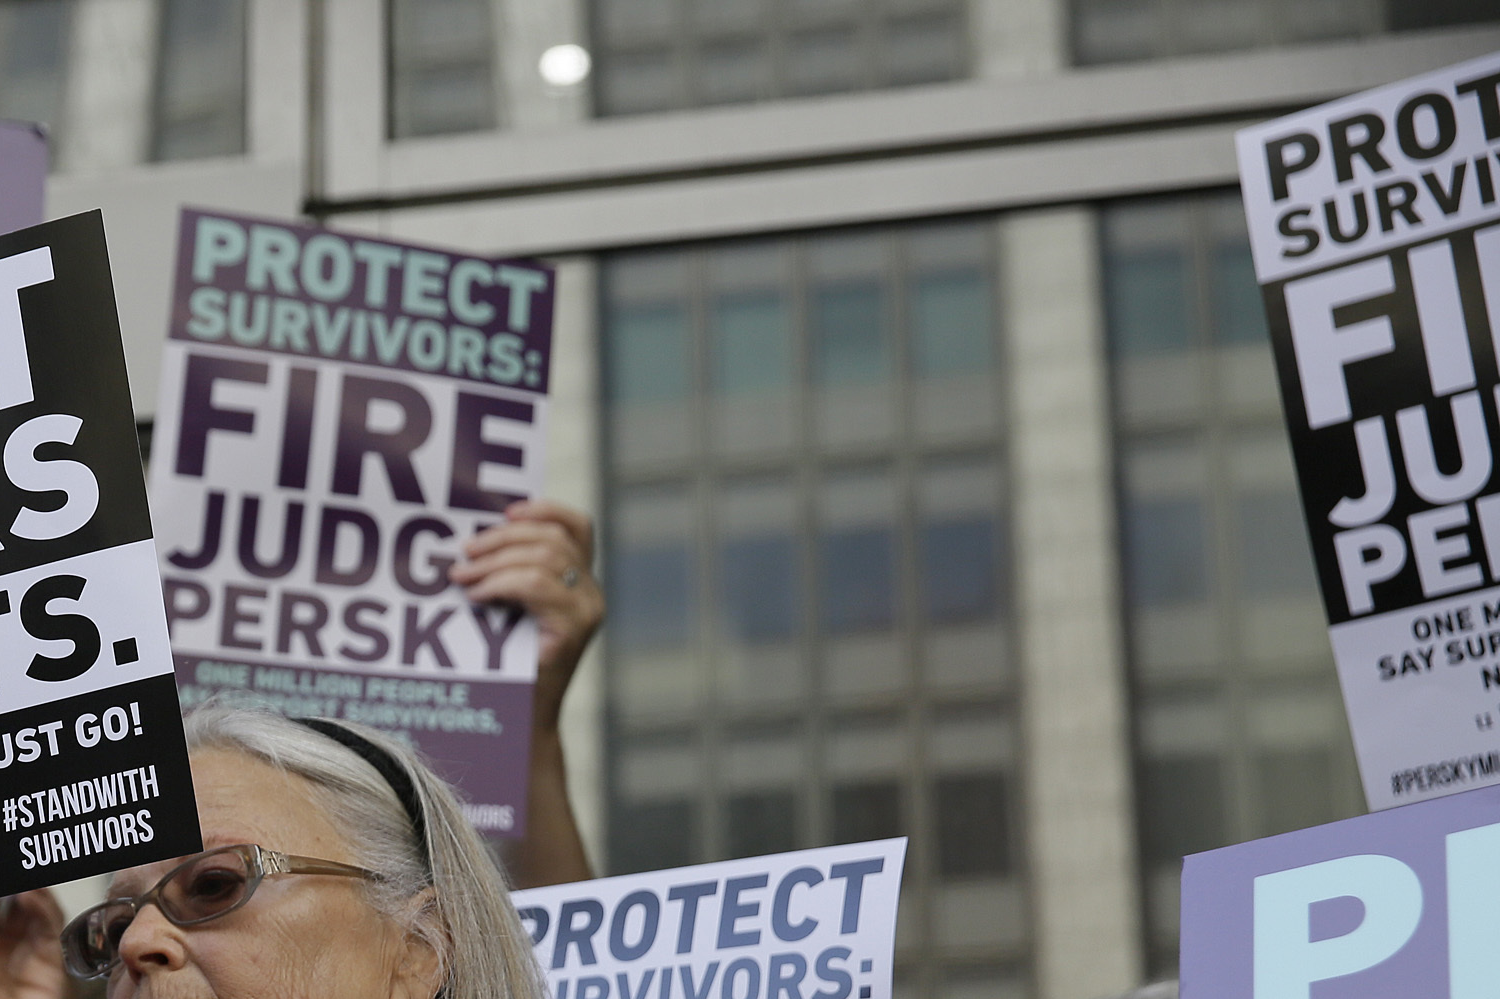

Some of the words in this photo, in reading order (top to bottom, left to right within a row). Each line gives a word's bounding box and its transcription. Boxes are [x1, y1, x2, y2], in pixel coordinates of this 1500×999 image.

[1277, 154, 1500, 258] SURVI
[192, 217, 548, 334] PROTECT
[189, 288, 542, 387] SURVIVORS:
[175, 353, 536, 511] FIRE
[166, 491, 498, 597] JUDG
[164, 576, 525, 671] PERSKY
[1378, 645, 1434, 681] SAY
[1413, 607, 1473, 641] ONE
[75, 702, 143, 748] GO!
[254, 667, 364, 700] MILLION
[366, 678, 470, 706] PEOPLE
[2, 765, 160, 832] #STANDWITH
[19, 809, 155, 870] SURVIVORS
